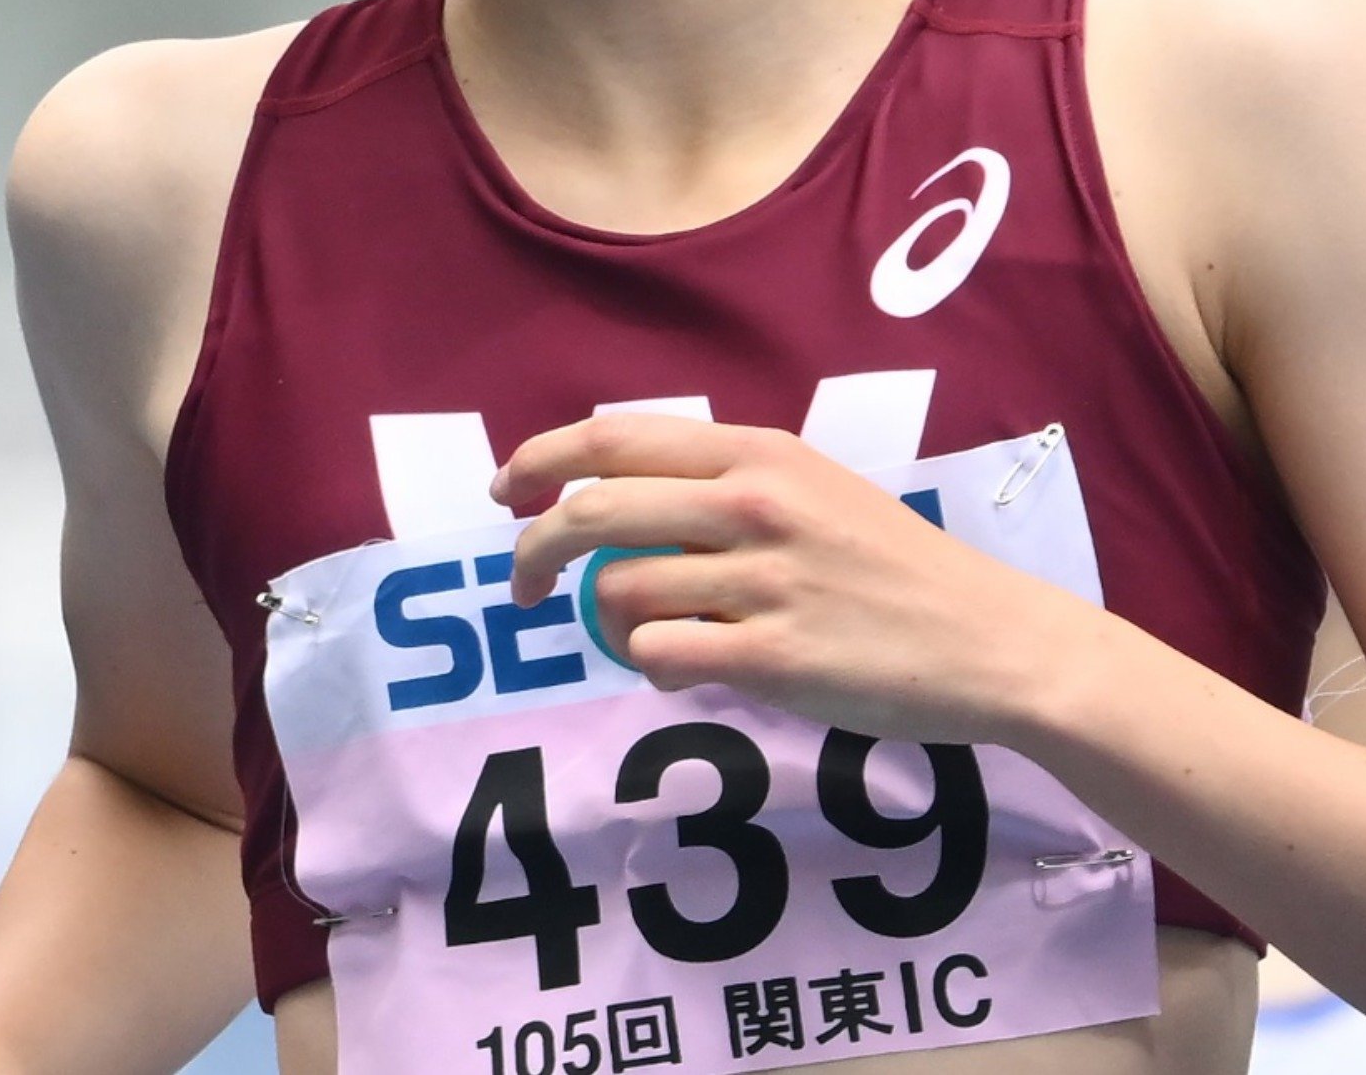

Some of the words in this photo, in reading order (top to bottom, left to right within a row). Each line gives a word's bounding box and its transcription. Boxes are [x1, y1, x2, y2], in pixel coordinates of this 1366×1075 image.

[444, 721, 990, 991] 439
[476, 995, 682, 1075] 105回
[723, 953, 993, 1059] 関東IC
